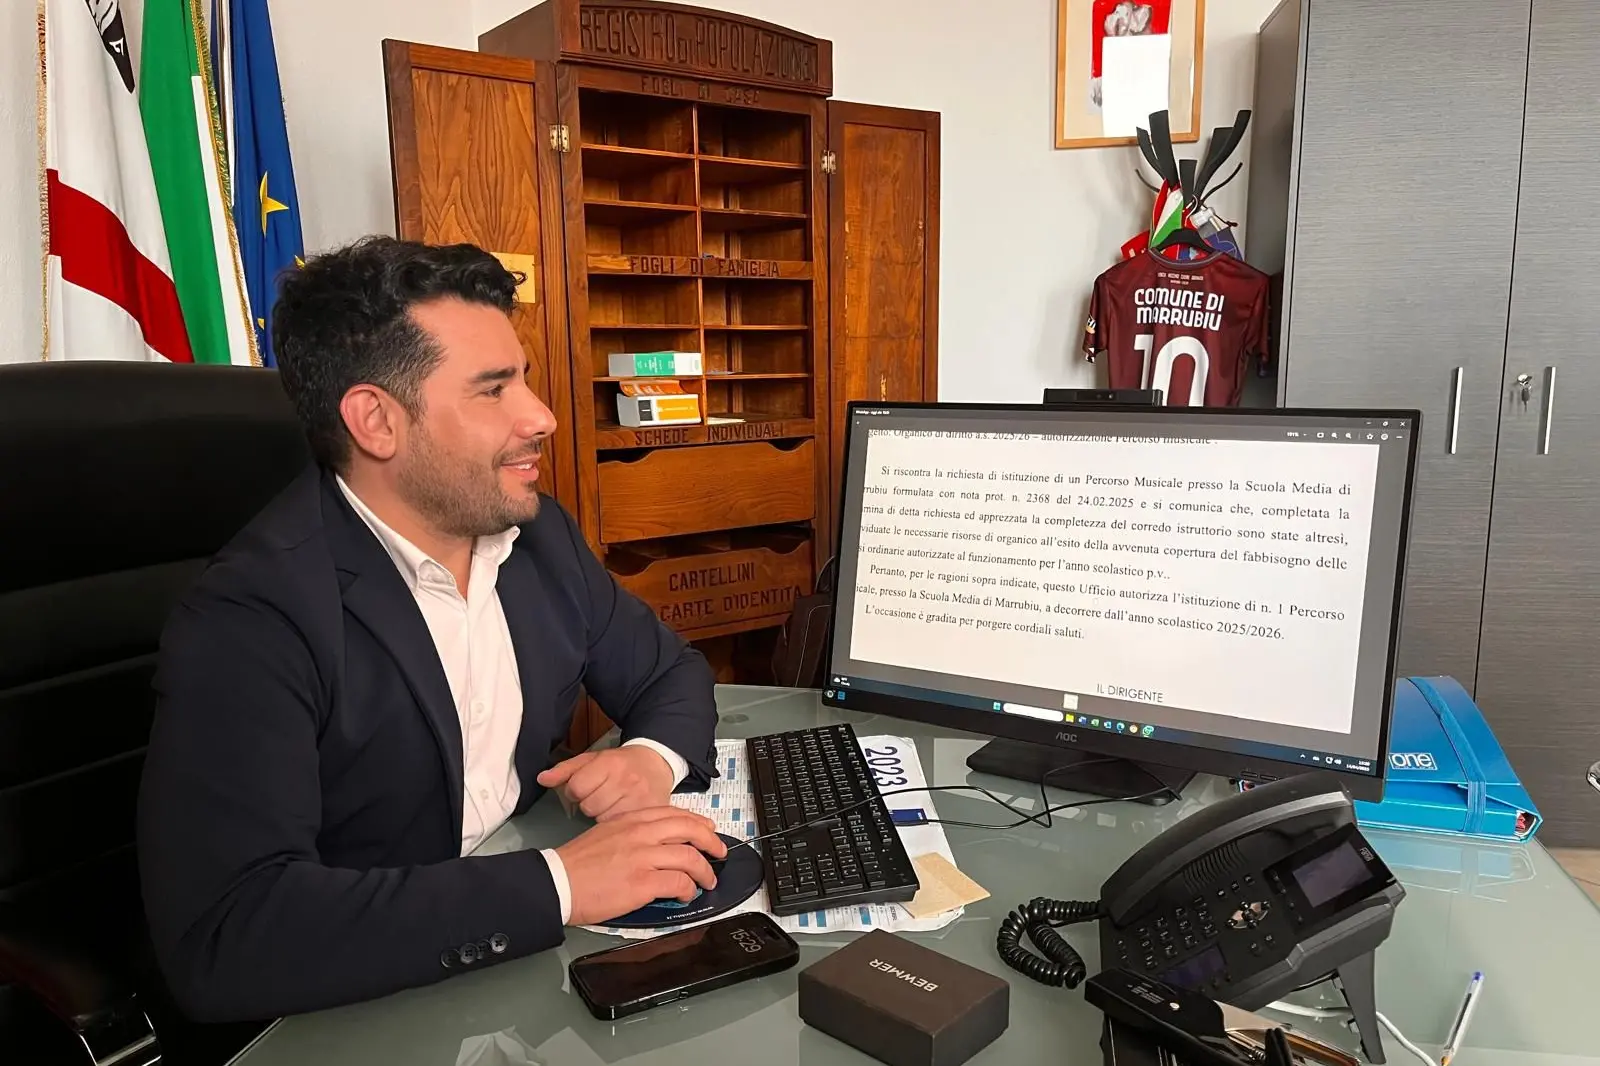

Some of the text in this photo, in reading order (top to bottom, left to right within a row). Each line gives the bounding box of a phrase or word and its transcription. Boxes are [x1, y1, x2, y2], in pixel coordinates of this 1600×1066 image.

[580, 8, 676, 62] REGISTRO
[696, 18, 816, 82] POPOLAZIONE
[630, 256, 780, 277] FOGLI DI FAMIGLIA
[1135, 288, 1224, 312] COMUNE DI
[1136, 307, 1222, 331] MARRUBIU
[1134, 334, 1209, 406] 10
[635, 424, 784, 445] SCHEDE INDIVIDUALI
[881, 465, 1350, 496] Si riscontra la richiesta di istituzione di un Percorso Musicale presso la Scuola Media di
[893, 486, 934, 497] formulata
[938, 490, 955, 499] con
[960, 491, 980, 500] nota
[984, 493, 1005, 503] prot.
[1012, 494, 1020, 502] n.
[1026, 493, 1050, 504] 2368
[1056, 494, 1071, 505] del
[1077, 495, 1134, 508] 24.02.2025
[1153, 499, 1162, 510] si
[1168, 501, 1222, 513] comunica
[1230, 503, 1254, 516] che,
[1261, 506, 1330, 520] completata
[1339, 508, 1350, 520] la
[886, 505, 895, 515] di
[898, 506, 920, 517] detta
[923, 508, 960, 520] richiesta
[964, 510, 975, 520] ed
[978, 514, 1028, 524] apprezzata
[1032, 514, 1040, 524] la
[1044, 516, 1106, 529] completezza
[1110, 519, 1127, 530] del
[1131, 522, 1172, 533] corredo
[1176, 522, 1232, 537] istruttorio
[1236, 530, 1265, 540] sono
[1270, 531, 1299, 542] state
[867, 544, 904, 556] ordinarie
[906, 549, 955, 560] autorizzate
[956, 550, 966, 561] al
[968, 551, 1036, 567] funzionamento
[1039, 560, 1056, 571] per
[1092, 562, 1144, 577] scolastico
[893, 525, 902, 536] le
[904, 528, 948, 539] necessarie
[951, 530, 982, 541] risorse
[984, 532, 994, 542] di
[996, 534, 1038, 546] organico
[1083, 539, 1108, 550] della
[1112, 543, 1159, 554] avvenuta
[1163, 547, 1216, 559] copertura
[1220, 549, 1238, 561] del
[1243, 550, 1310, 569] fabbisogno
[1315, 556, 1347, 570] delle
[669, 562, 756, 592] CARTELLINI
[869, 564, 906, 578] Pertanto,
[909, 570, 924, 581] per
[926, 569, 935, 580] le
[937, 572, 968, 584] ragioni
[972, 576, 996, 587] sopra
[999, 576, 1039, 591] indicate,
[1042, 582, 1076, 594] questo
[1079, 584, 1116, 597] Ufficio
[1119, 590, 1168, 602] autorizza
[1244, 600, 1256, 612] di
[1261, 604, 1272, 614] n.
[1278, 603, 1282, 615] 1
[1289, 604, 1344, 621] Percorso
[660, 598, 714, 622] CARTE
[879, 588, 906, 598] presso
[908, 588, 917, 599] la
[919, 589, 949, 602] Scuola
[951, 592, 980, 605] Media
[982, 596, 992, 607] di
[994, 597, 1042, 613] Marrubiu,
[1045, 604, 1051, 613] a
[1053, 603, 1102, 618] decorrere
[1157, 616, 1213, 631] scolastico
[1216, 621, 1284, 640] 2025/2026.
[925, 612, 956, 624] gradita
[958, 617, 974, 627] per
[976, 619, 1012, 631] porgere
[1014, 622, 1052, 635] cordiali
[1054, 626, 1084, 639] saluti.
[1097, 683, 1163, 703] IL DIRIGENTE
[1055, 732, 1078, 743] AOC
[865, 746, 908, 786] 2023
[1391, 754, 1432, 767] one
[730, 929, 762, 952] 15:29
[869, 959, 938, 992] BEWMER
